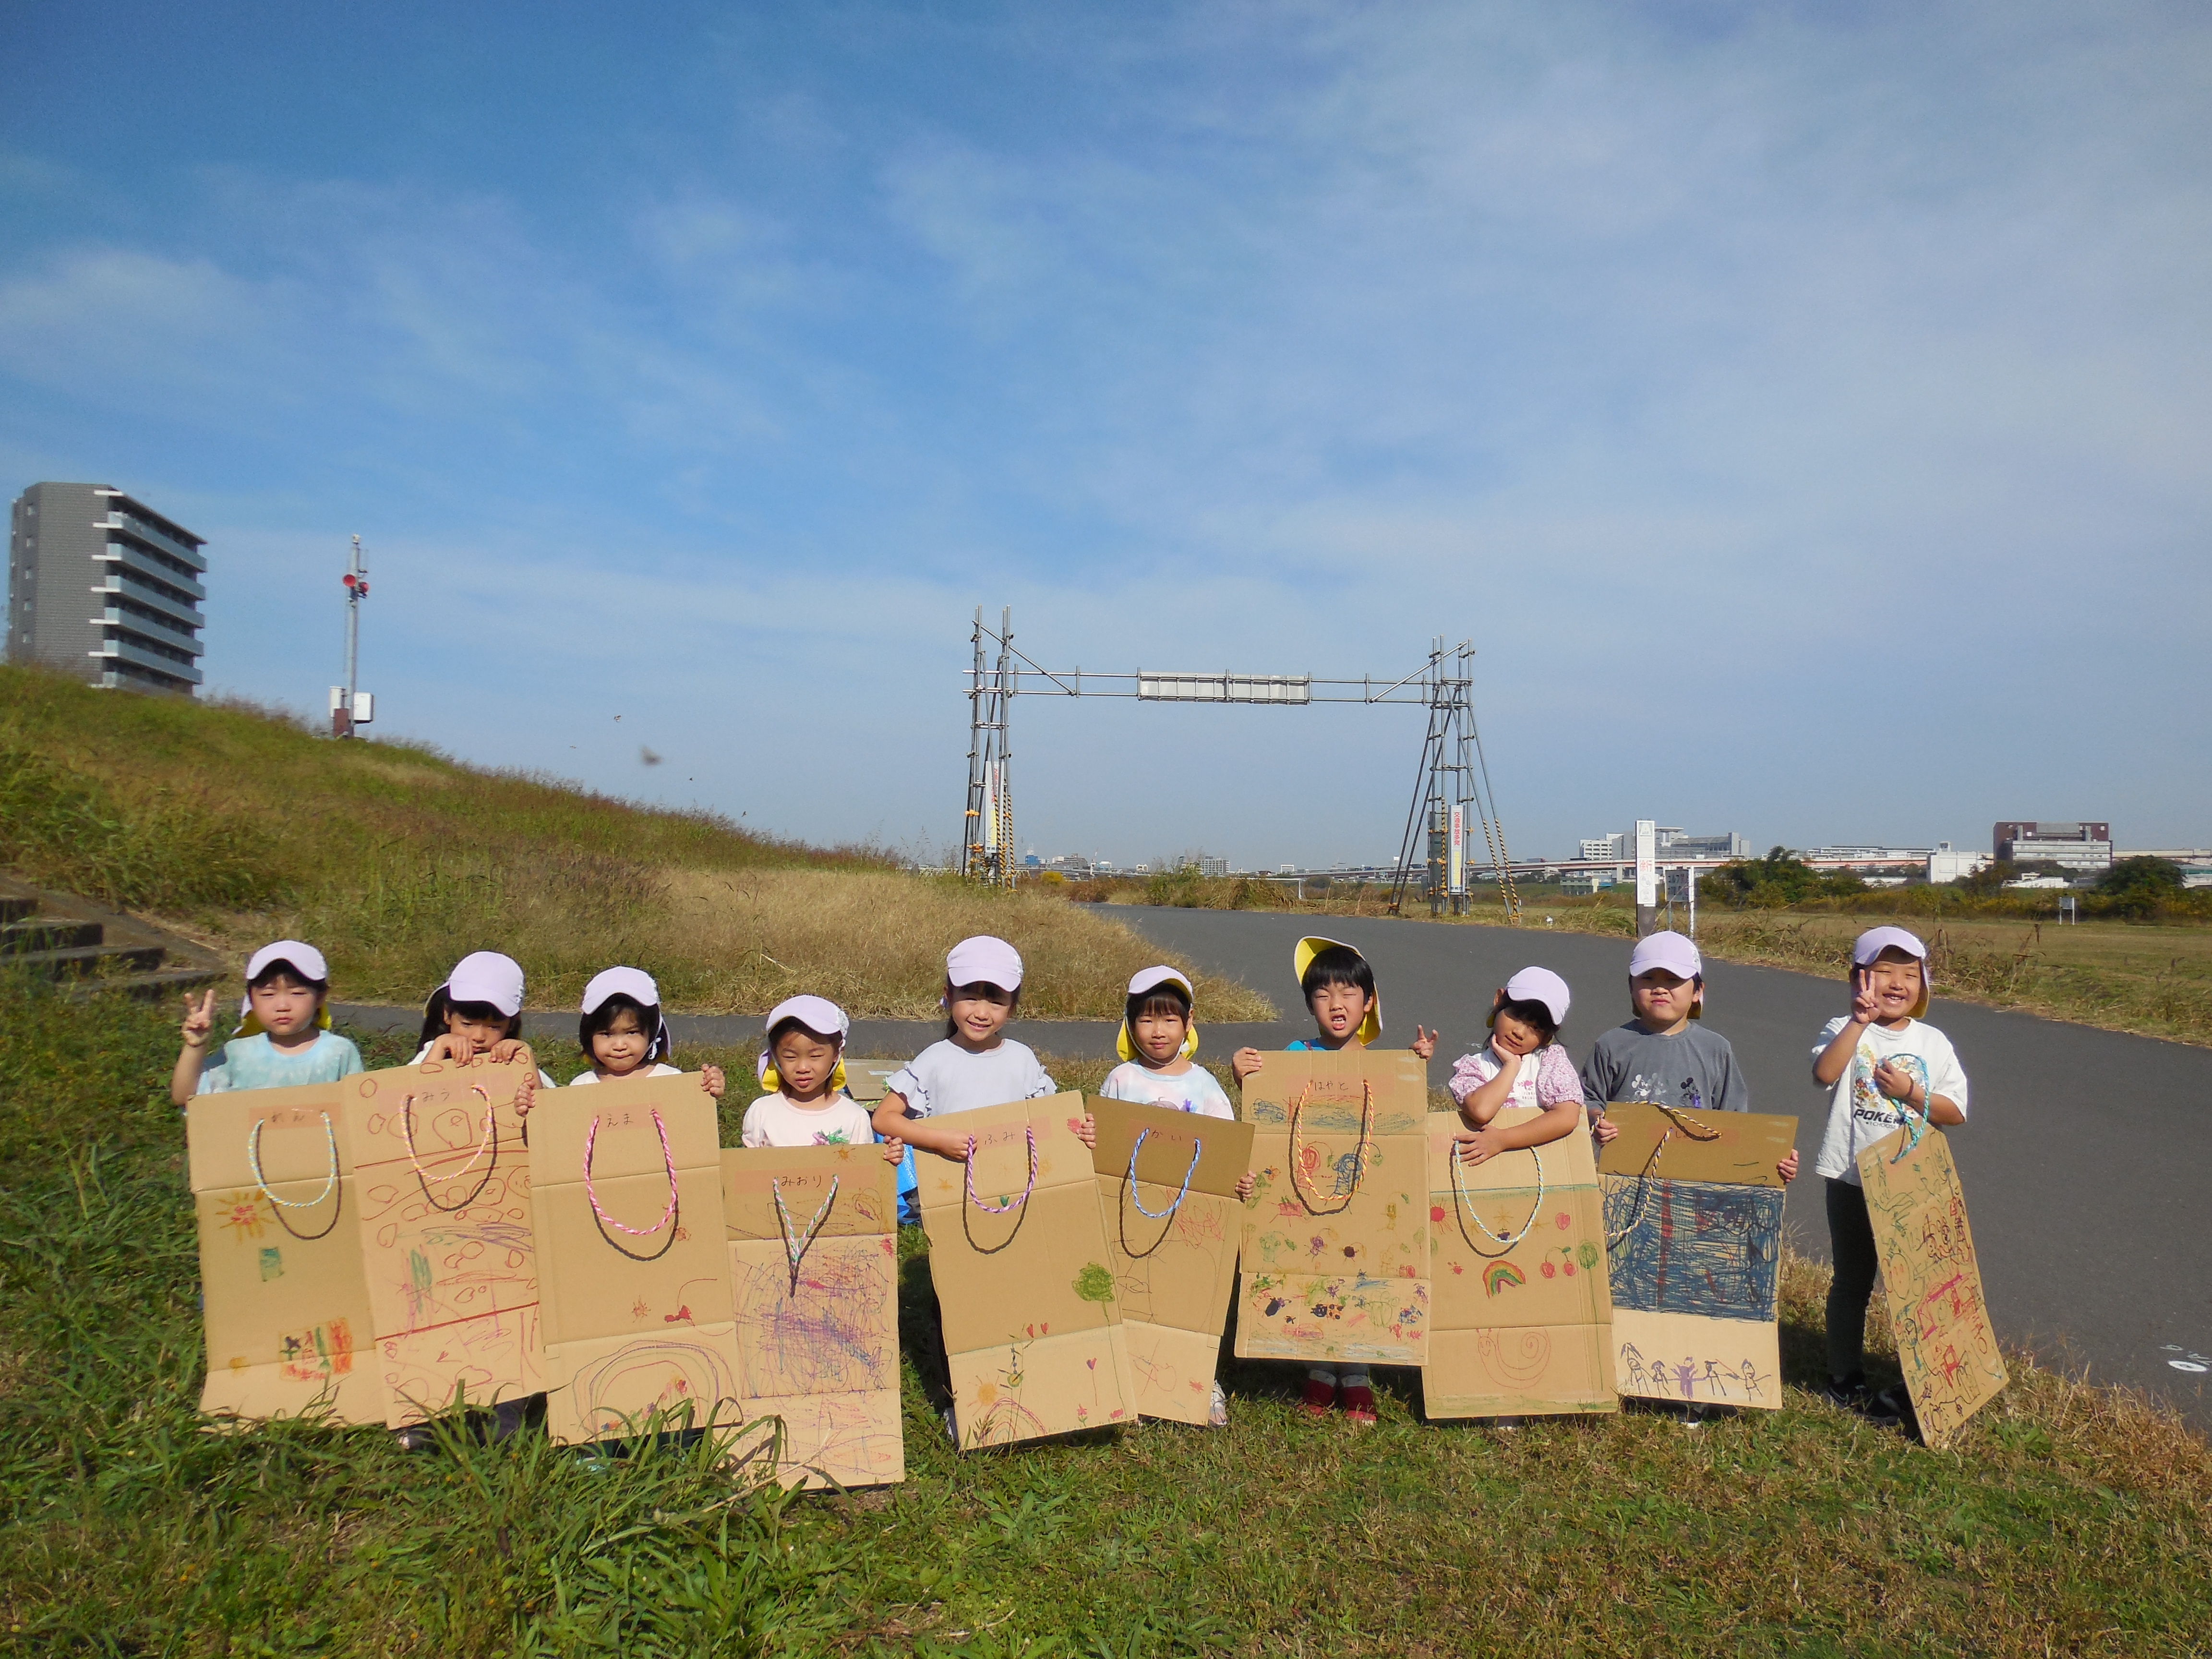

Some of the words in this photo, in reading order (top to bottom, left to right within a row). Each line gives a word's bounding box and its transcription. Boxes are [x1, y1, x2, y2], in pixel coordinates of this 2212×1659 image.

[1314, 1081, 1348, 1091] はやと
[607, 1113, 634, 1128] えま
[984, 1131, 1015, 1145] ふみ
[1151, 1130, 1181, 1141] かい
[781, 1175, 822, 1188] みおり
